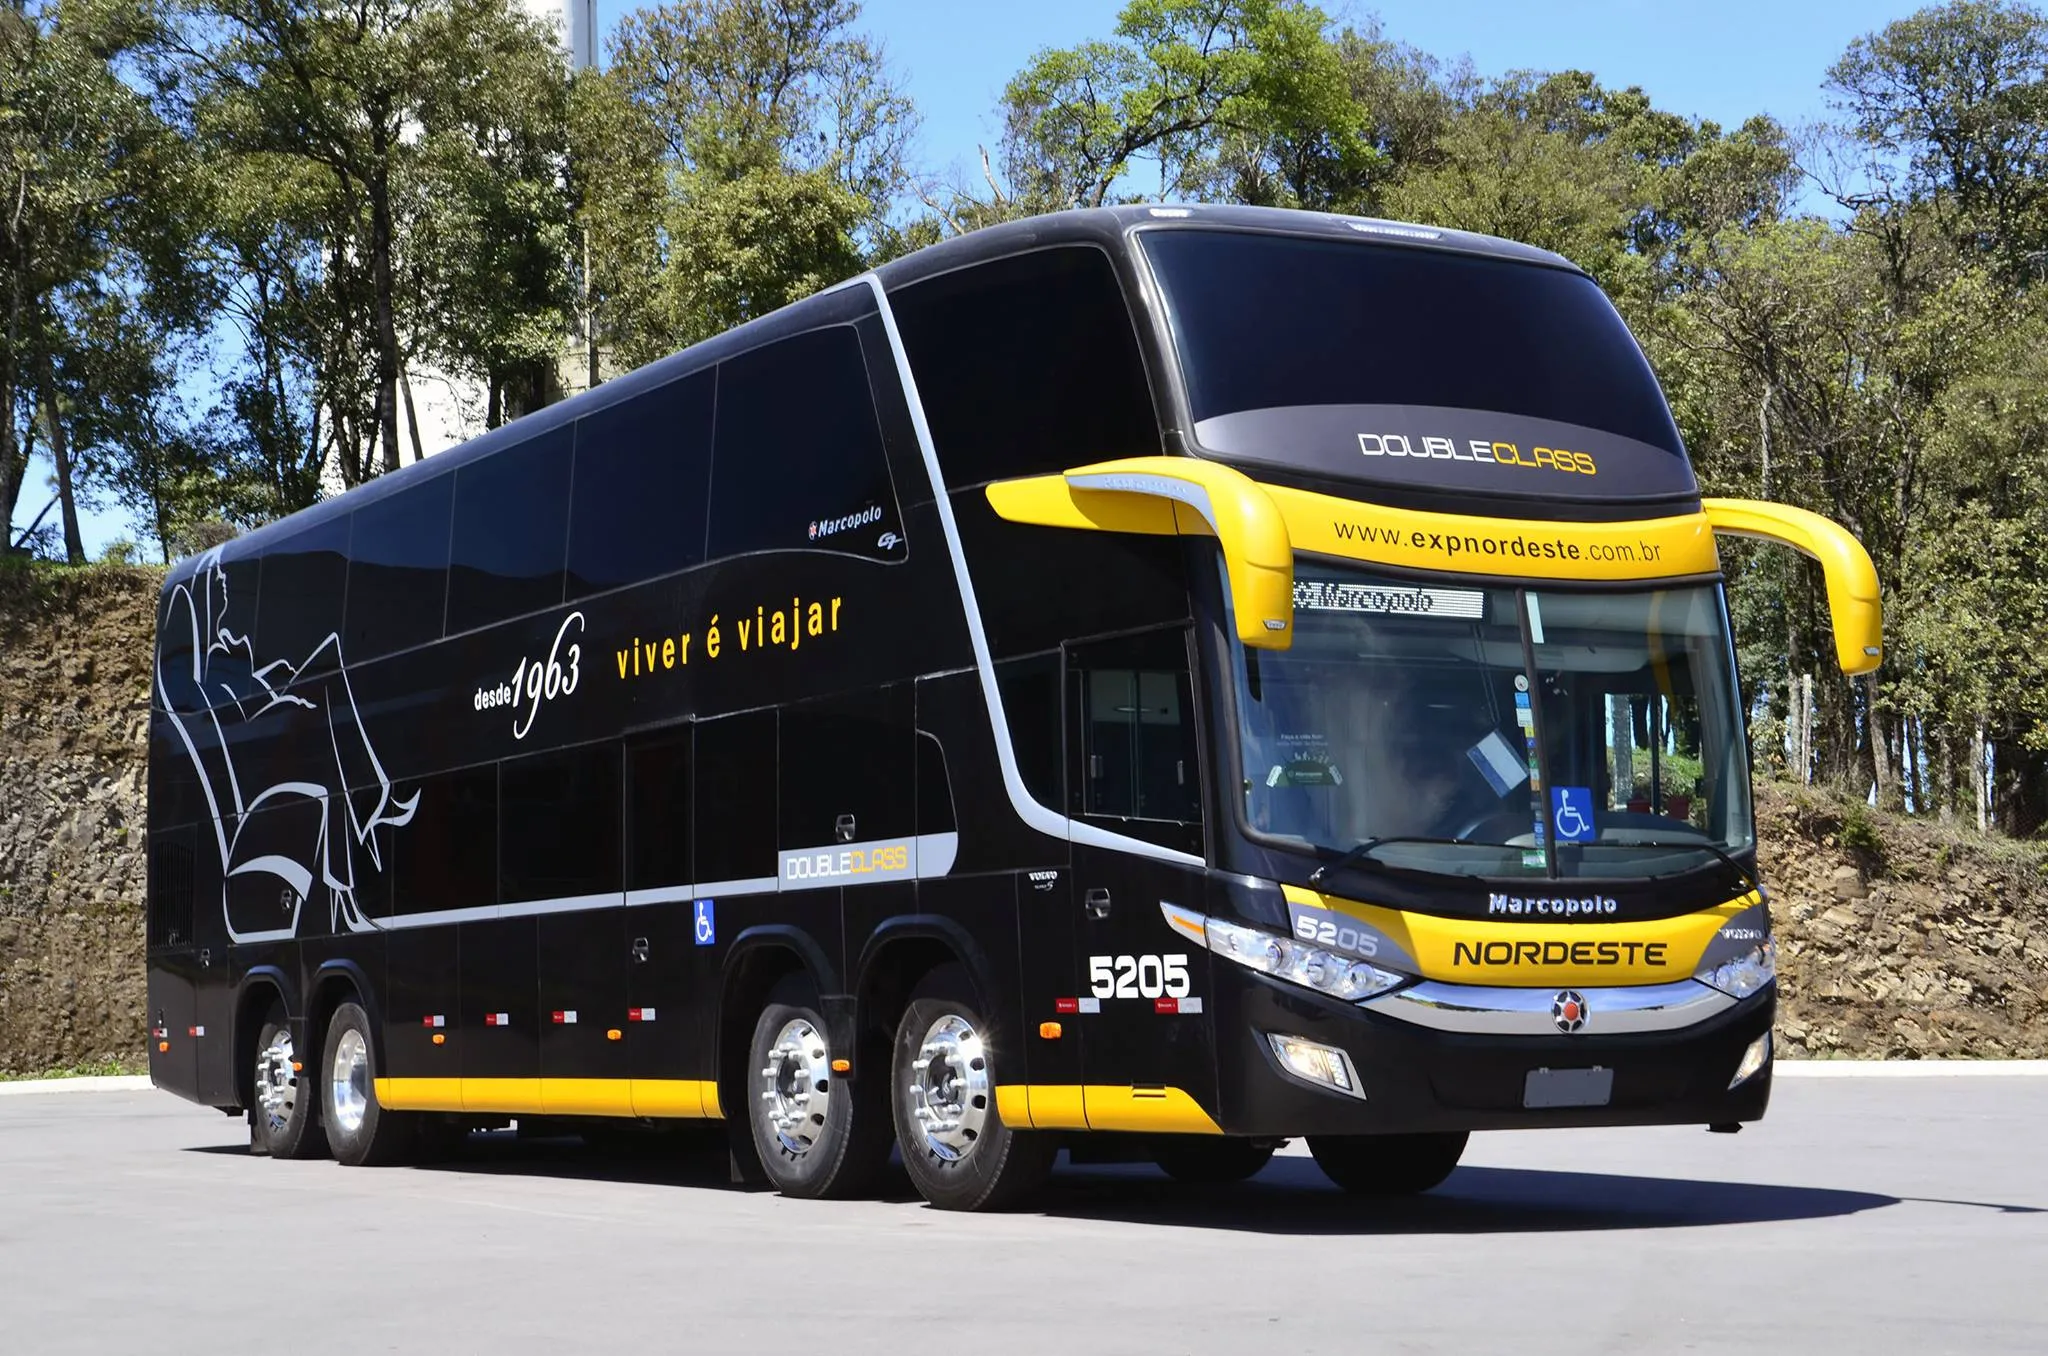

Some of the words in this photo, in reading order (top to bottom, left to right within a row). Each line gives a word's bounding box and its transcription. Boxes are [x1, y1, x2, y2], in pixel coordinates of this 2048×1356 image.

[1357, 433, 1597, 475] DOUBLECLASS
[818, 506, 882, 538] Marcopolo
[1334, 520, 1662, 563] www.expnordeste.com.br
[1319, 583, 1434, 613] Marcopolo
[616, 632, 690, 680] viver
[706, 614, 721, 658] é
[738, 596, 842, 651] viajar
[474, 682, 511, 711] desde
[511, 611, 585, 740] 1963
[786, 846, 907, 880] DOUBLECLASS
[1488, 893, 1617, 917] Marcopolo
[1296, 915, 1378, 956] 5205
[1453, 941, 1667, 967] NORDESTE
[1089, 954, 1190, 999] 5205
